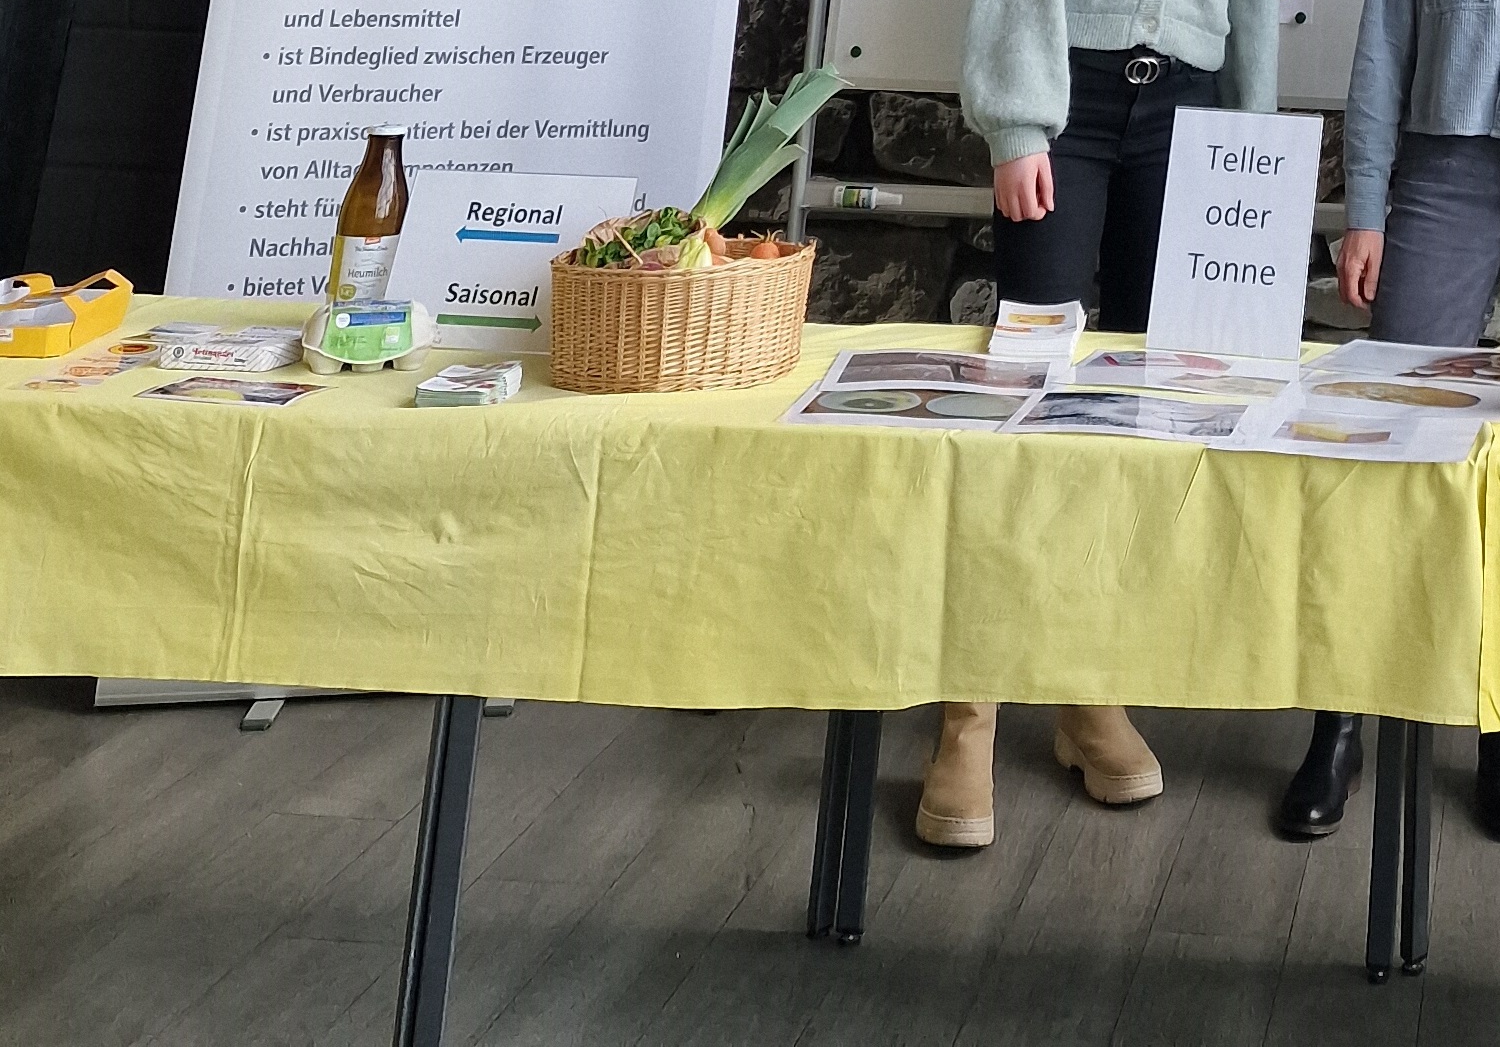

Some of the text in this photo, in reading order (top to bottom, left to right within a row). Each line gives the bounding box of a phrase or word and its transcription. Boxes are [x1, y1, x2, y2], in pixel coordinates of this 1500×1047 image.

[283, 8, 461, 29] und Lebensmittel
[277, 46, 610, 71] ist Bindeglied zwischen Erzeuger
[272, 84, 443, 105] und Verbraucher
[266, 119, 650, 147] ist praxisotiert bei der Vermittlung
[1207, 144, 1286, 176] Teller
[261, 165, 299, 180] von
[254, 198, 308, 220] steht
[466, 201, 564, 228] Regional
[1205, 199, 1272, 230] oder
[248, 237, 334, 258] Nachhal
[347, 266, 389, 279] Heumilch
[1188, 252, 1276, 286] Tonne
[243, 277, 306, 298] bietet
[445, 282, 539, 309] Saisonal
